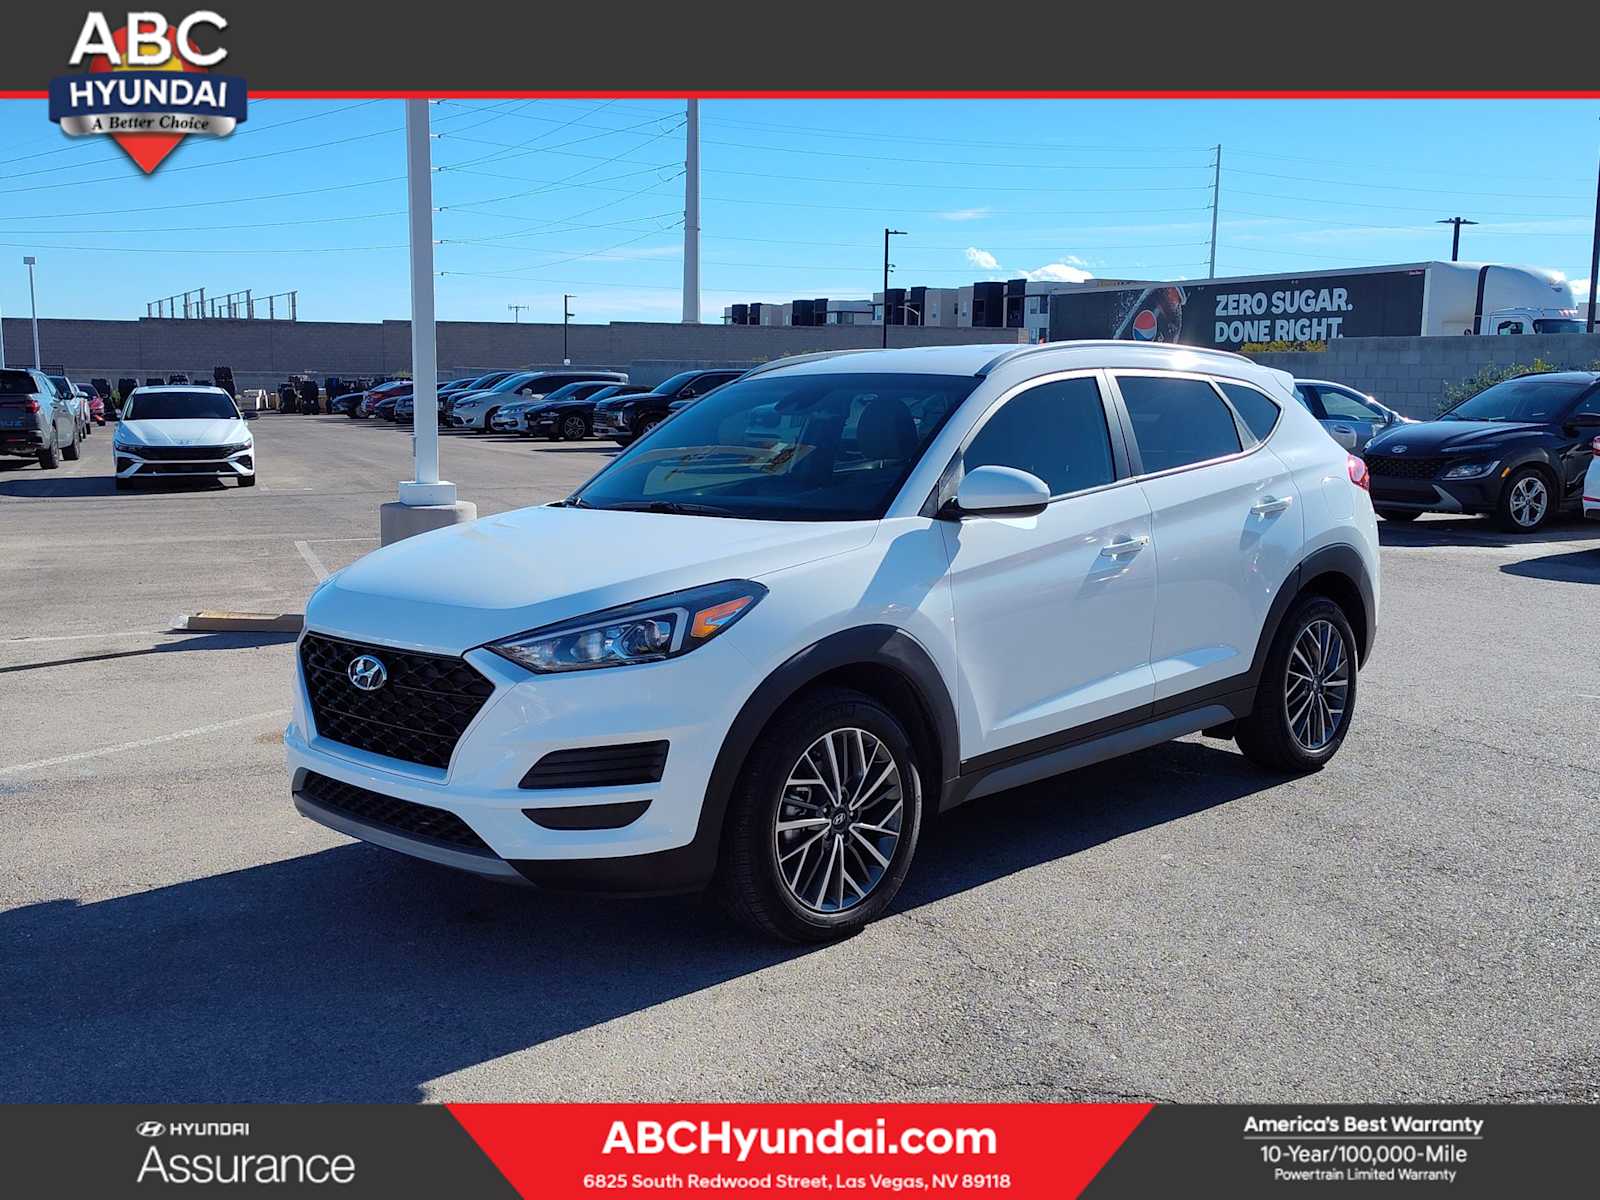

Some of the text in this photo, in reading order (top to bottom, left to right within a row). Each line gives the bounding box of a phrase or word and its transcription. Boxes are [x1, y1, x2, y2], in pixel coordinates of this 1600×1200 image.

[1215, 288, 1353, 316] ZERO SUGAR.
[1215, 317, 1344, 343] DONE RIGHT.
